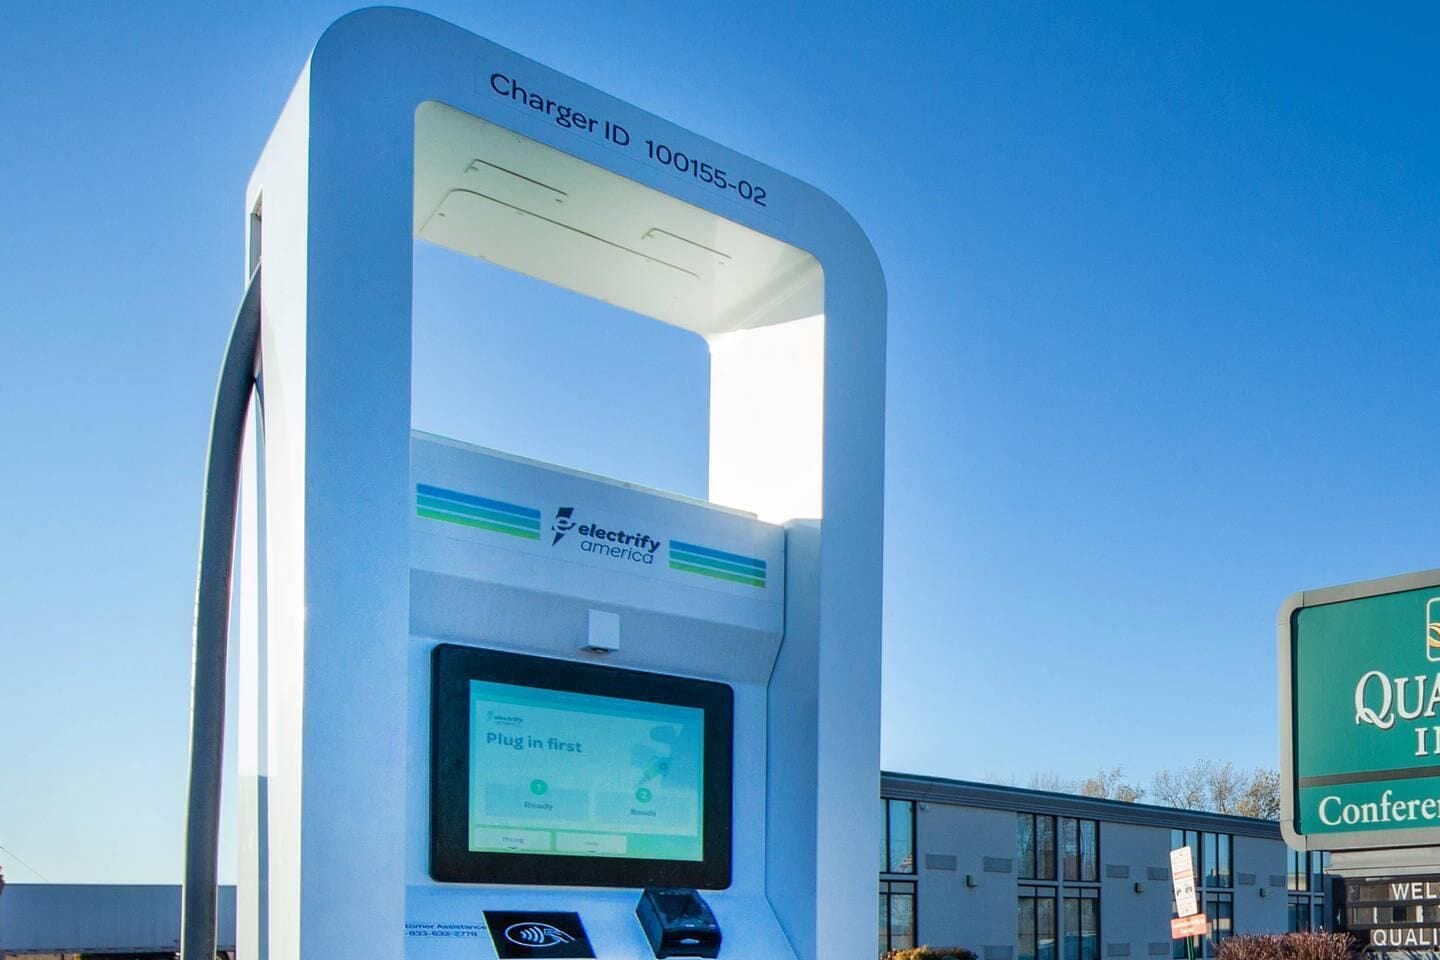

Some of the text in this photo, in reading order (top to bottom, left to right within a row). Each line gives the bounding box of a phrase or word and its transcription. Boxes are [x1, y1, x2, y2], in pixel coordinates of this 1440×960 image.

[489, 72, 768, 208] Charger ID 100155-02
[578, 523, 660, 553] electrify
[580, 540, 654, 564] america
[486, 732, 582, 753] Plug in first
